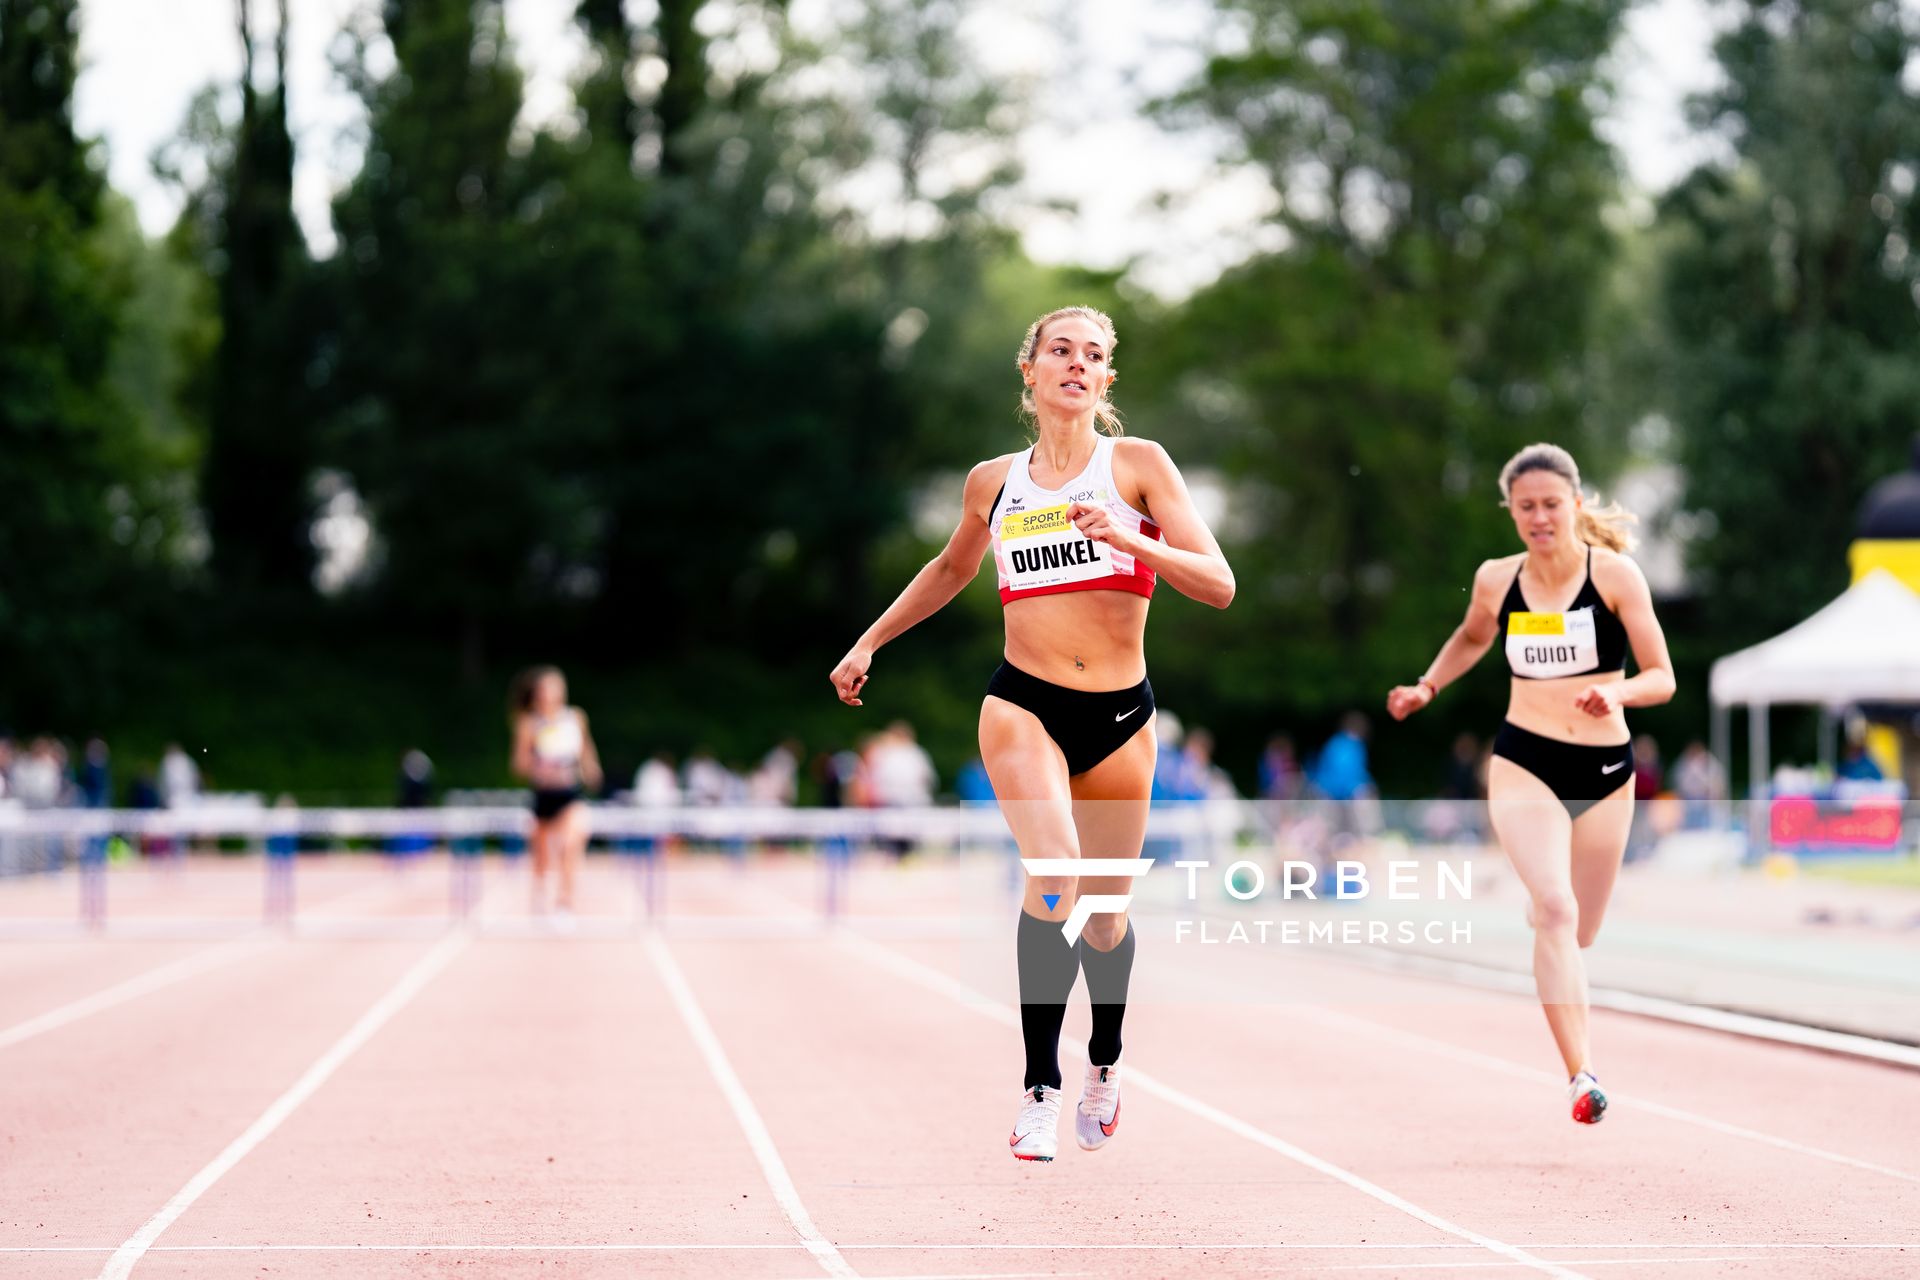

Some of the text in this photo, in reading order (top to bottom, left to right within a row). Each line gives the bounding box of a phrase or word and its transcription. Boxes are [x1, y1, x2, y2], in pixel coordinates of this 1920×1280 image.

[1022, 520, 1065, 532] VLAANDEREN
[1011, 539, 1101, 574] DUNKEL
[1524, 646, 1577, 663] GUIOT
